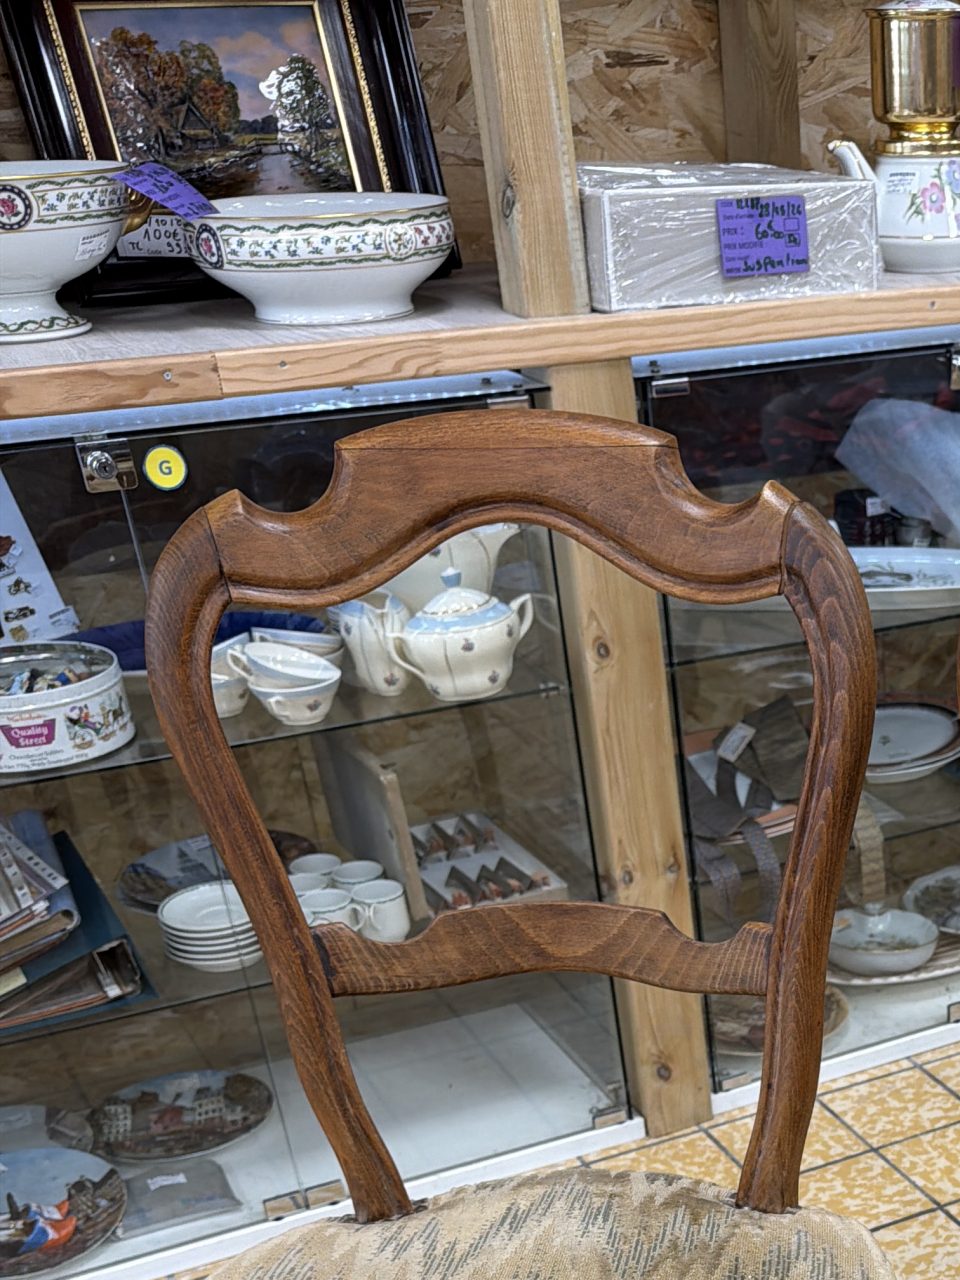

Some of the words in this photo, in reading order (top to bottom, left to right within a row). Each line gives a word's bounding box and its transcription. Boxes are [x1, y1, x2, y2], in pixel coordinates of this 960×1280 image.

[158, 459, 173, 476] G
[11, 726, 48, 738] Quality
[19, 736, 46, 745] Street
